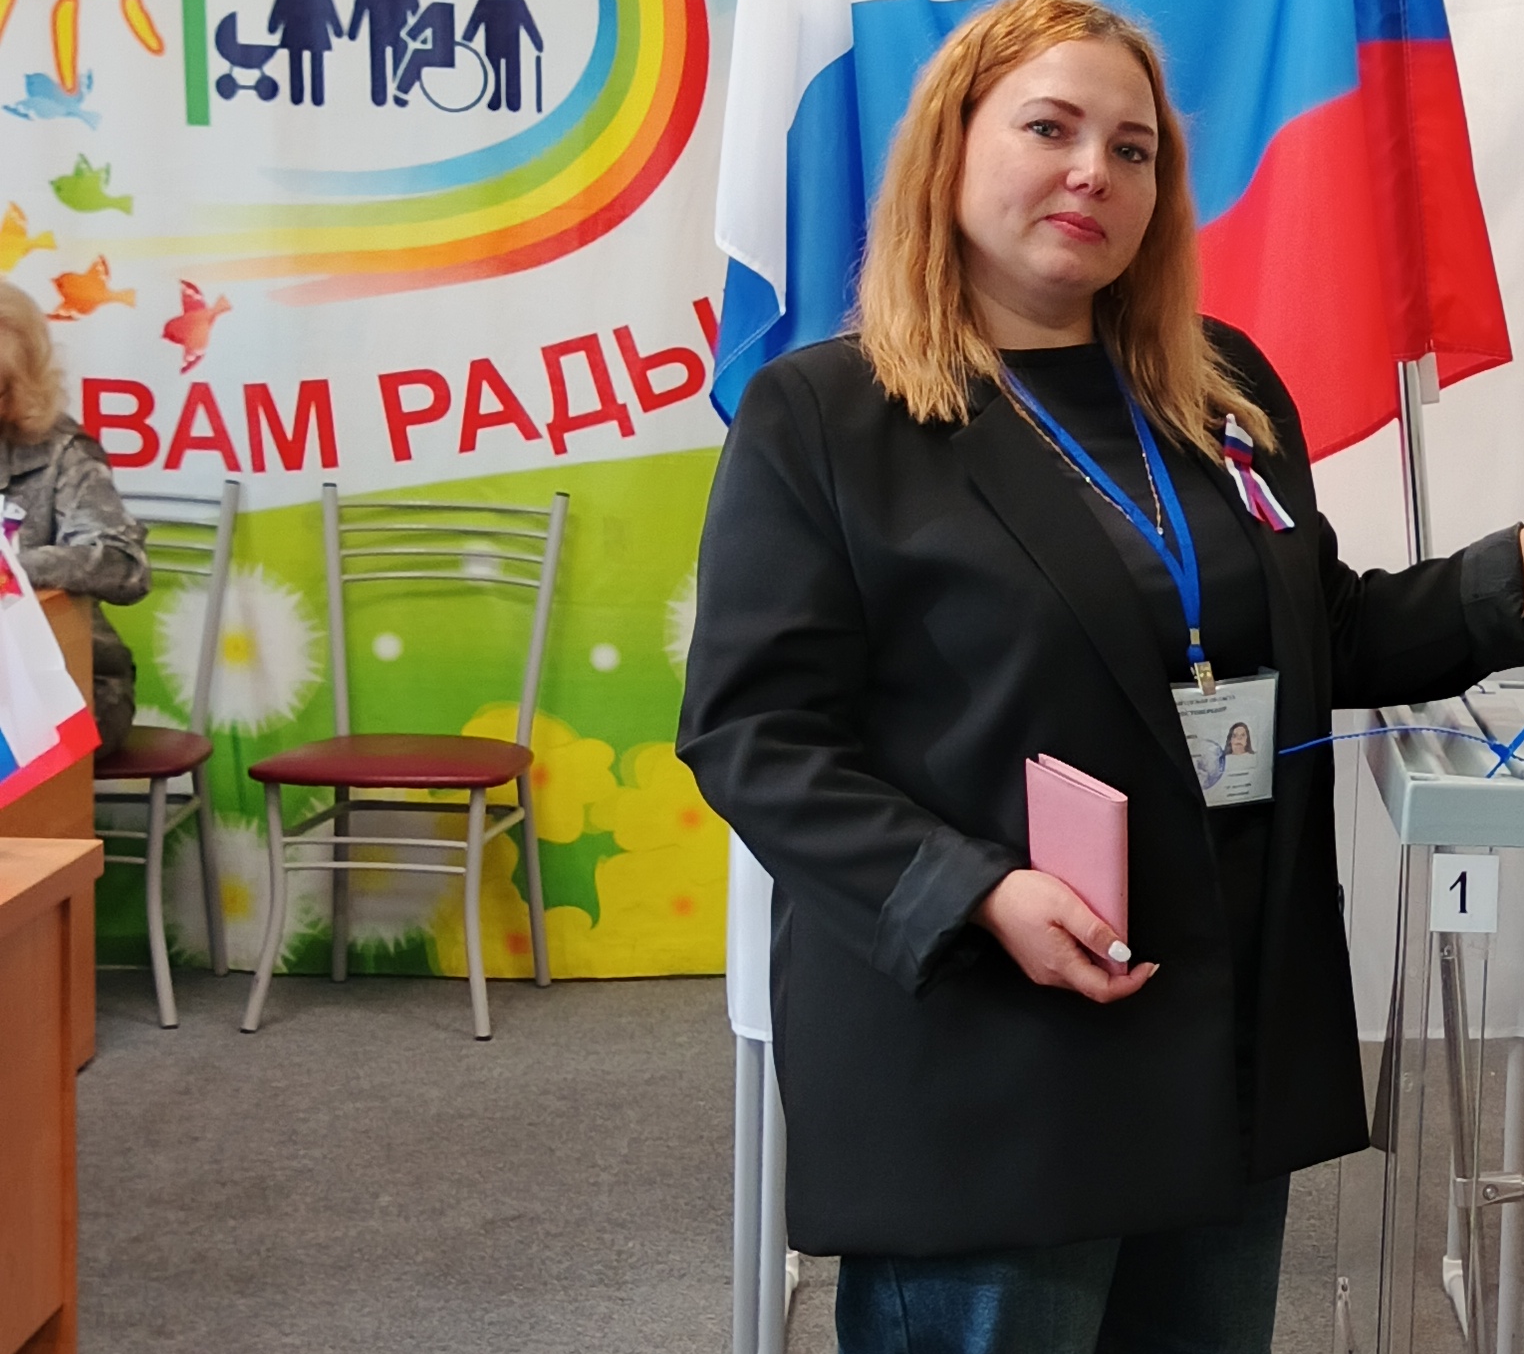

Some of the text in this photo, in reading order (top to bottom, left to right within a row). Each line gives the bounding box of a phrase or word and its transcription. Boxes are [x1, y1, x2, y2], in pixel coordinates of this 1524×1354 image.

[80, 296, 719, 474] ВАМ РАДЫ
[1449, 870, 1468, 914] 1
